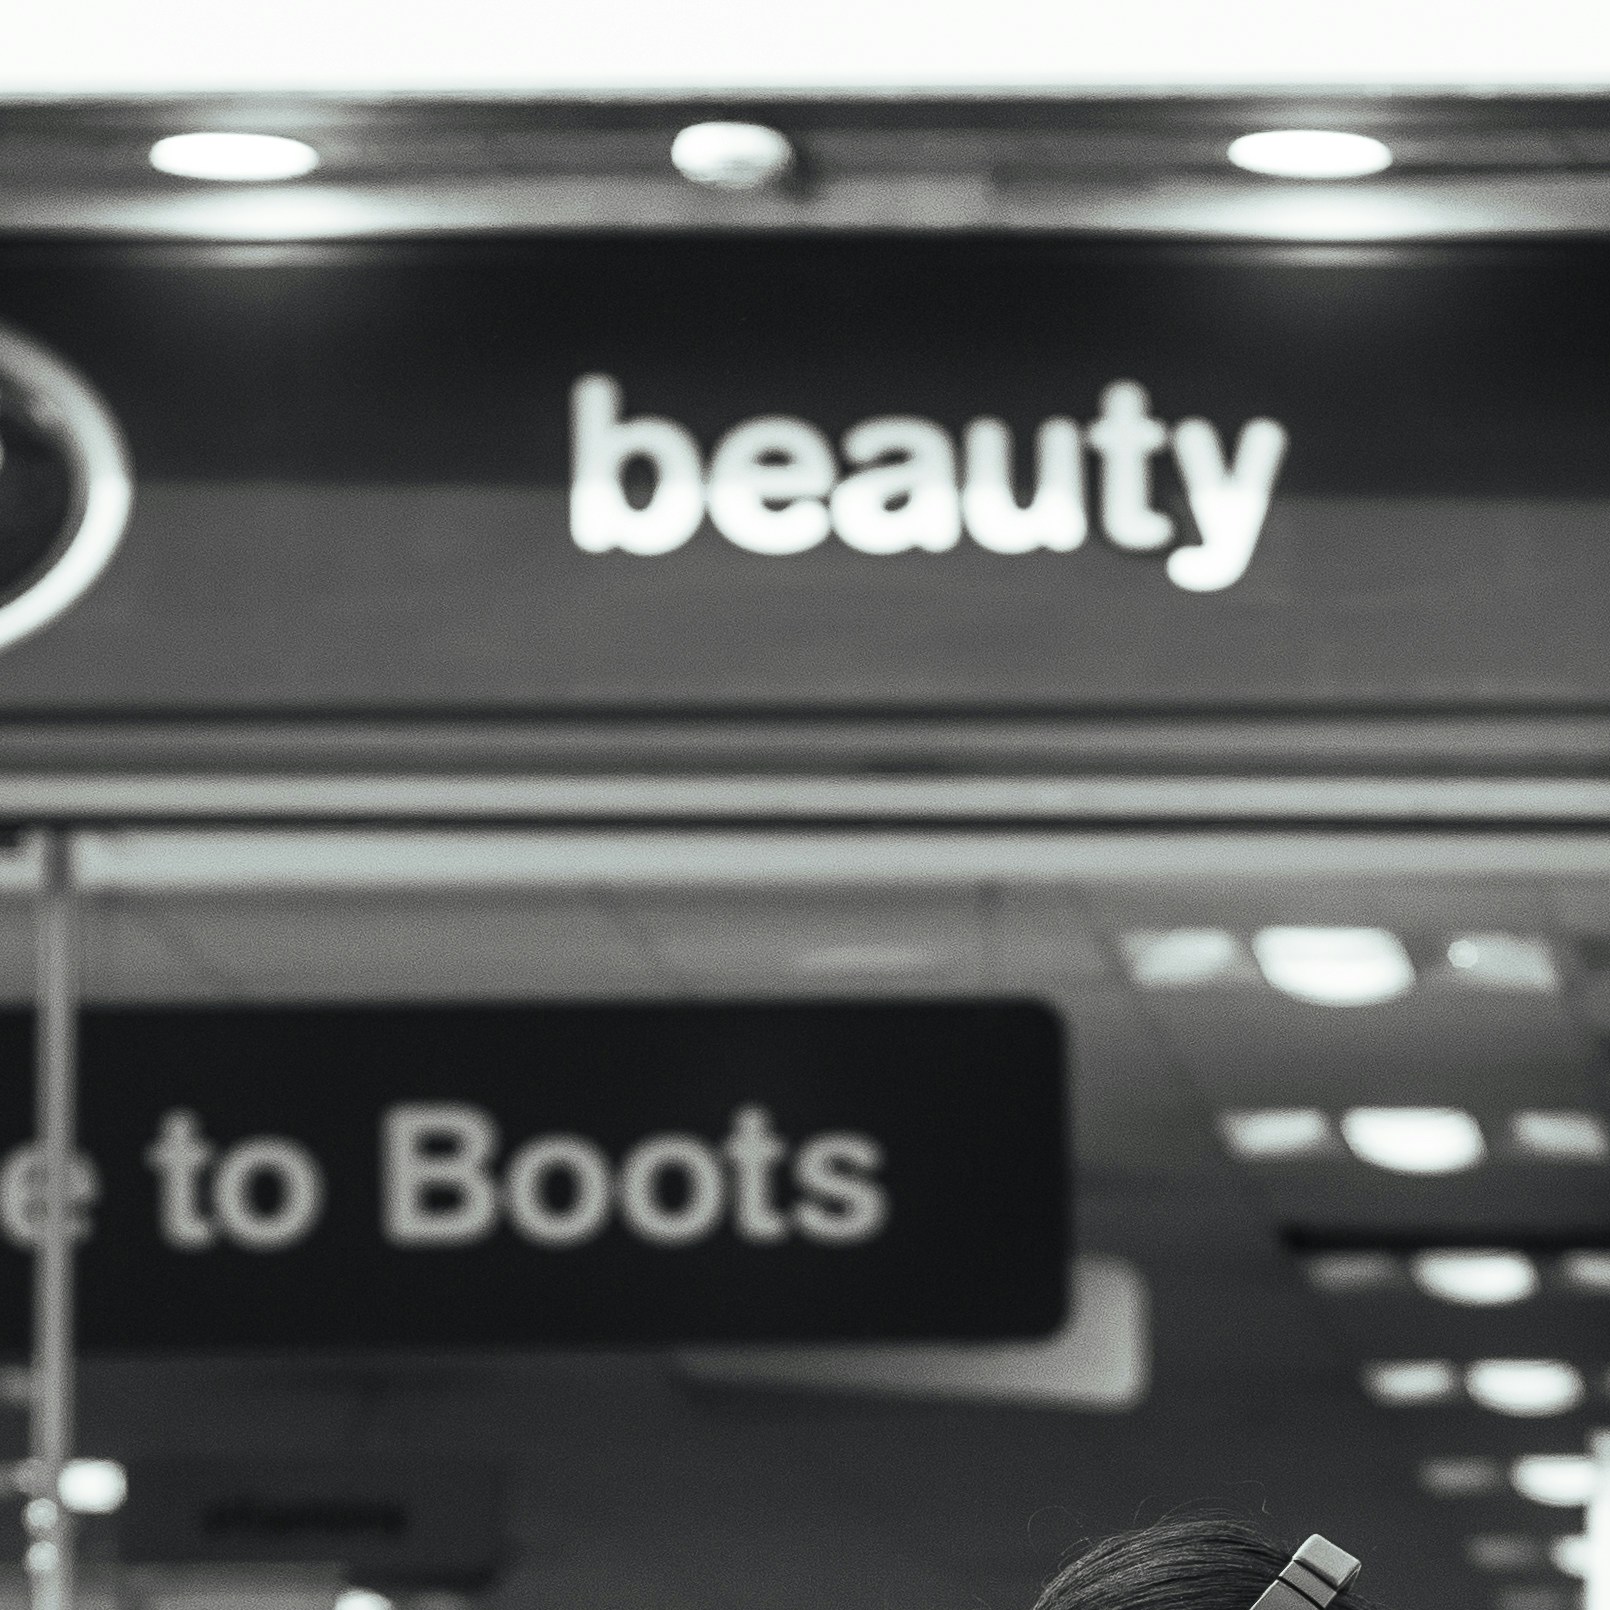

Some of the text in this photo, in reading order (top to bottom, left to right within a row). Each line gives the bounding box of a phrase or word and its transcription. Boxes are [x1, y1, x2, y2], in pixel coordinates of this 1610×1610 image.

[570, 375, 1287, 592] beauty
[148, 1108, 325, 1250] to
[380, 1102, 889, 1248] Boots
